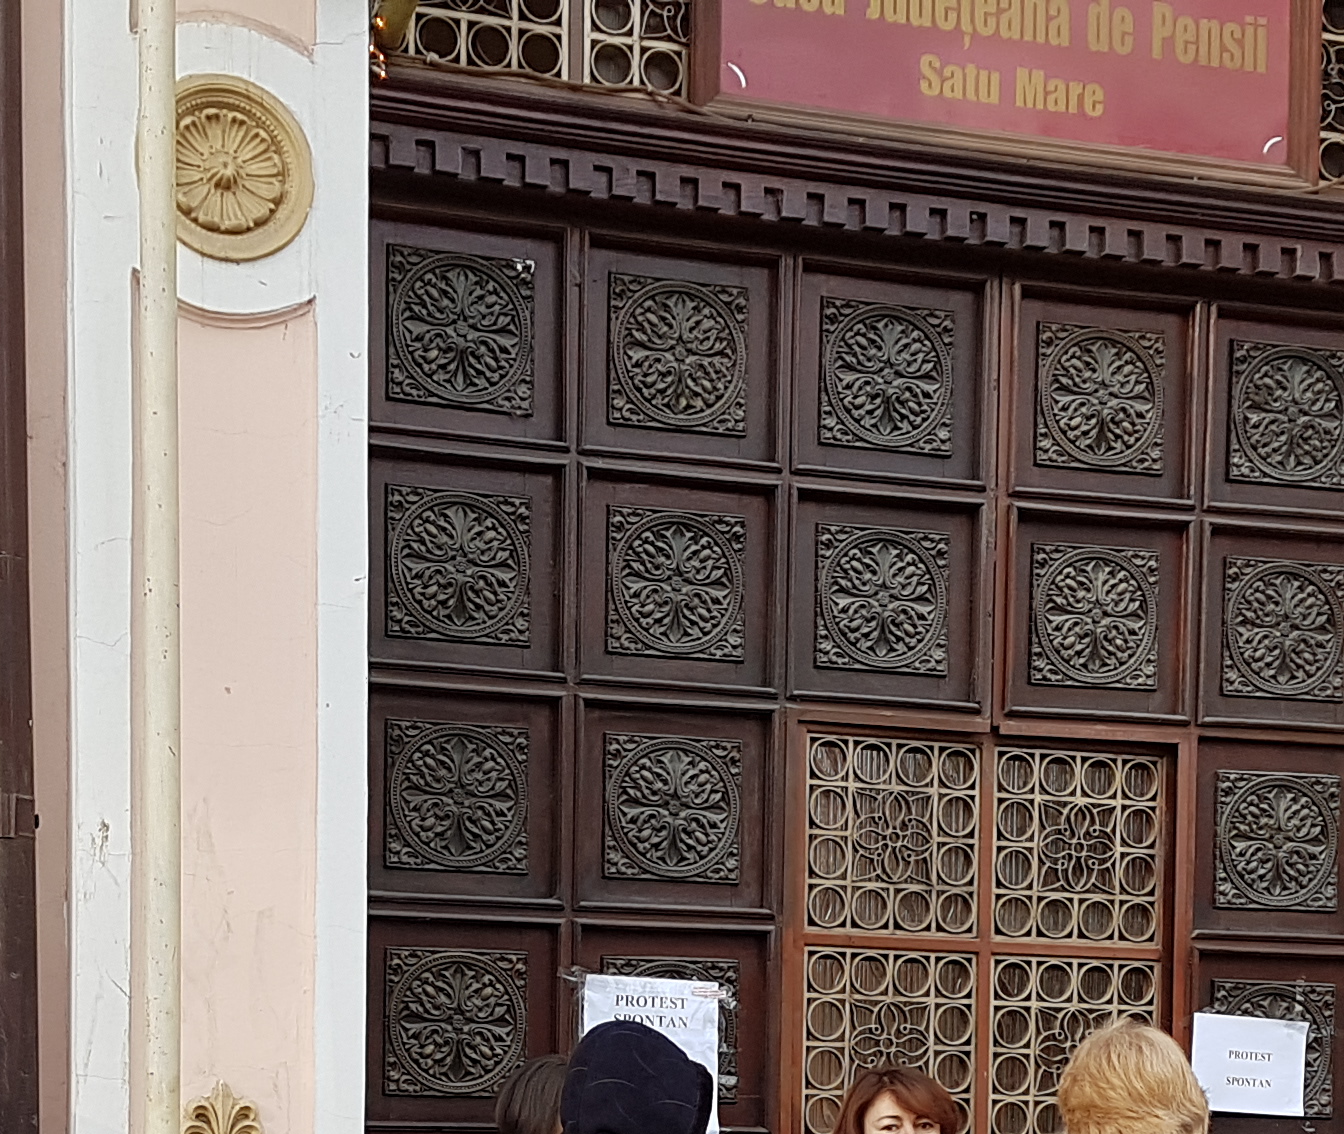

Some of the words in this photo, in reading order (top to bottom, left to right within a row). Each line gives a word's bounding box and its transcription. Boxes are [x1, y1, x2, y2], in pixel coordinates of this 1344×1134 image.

[1087, 0, 1134, 55] de
[1151, 2, 1268, 73] Pensii
[919, 53, 1000, 104] Satu
[1015, 66, 1104, 117] Mare
[615, 994, 688, 1010] PROTEST
[613, 1013, 688, 1029] SPONTAN
[1228, 1049, 1273, 1062] PROTEST
[1225, 1076, 1272, 1088] SPONTAN
